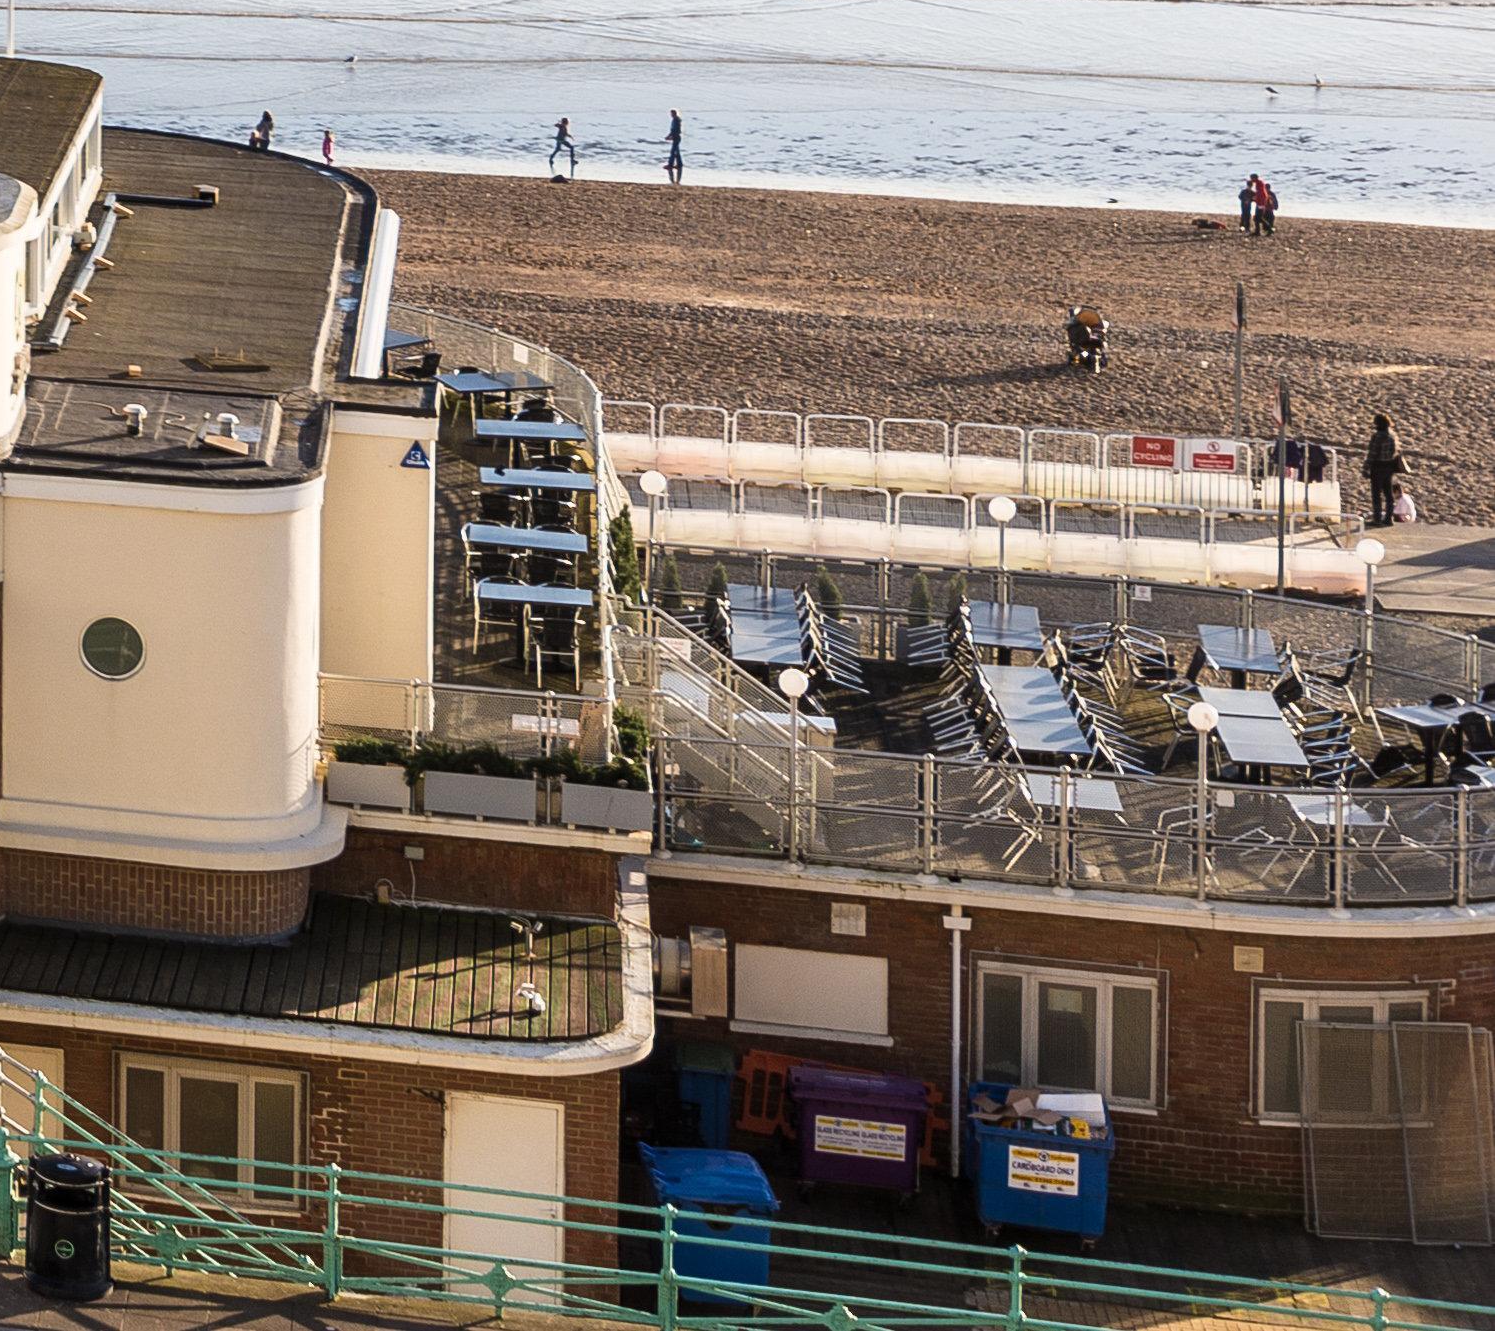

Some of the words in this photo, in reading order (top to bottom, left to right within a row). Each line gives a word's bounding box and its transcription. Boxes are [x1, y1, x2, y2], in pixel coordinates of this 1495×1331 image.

[1146, 442, 1161, 451] NO
[1134, 453, 1173, 463] CYCLING
[1012, 1161, 1055, 1174] CARDBOARD
[1057, 1167, 1074, 1176] ONLY
